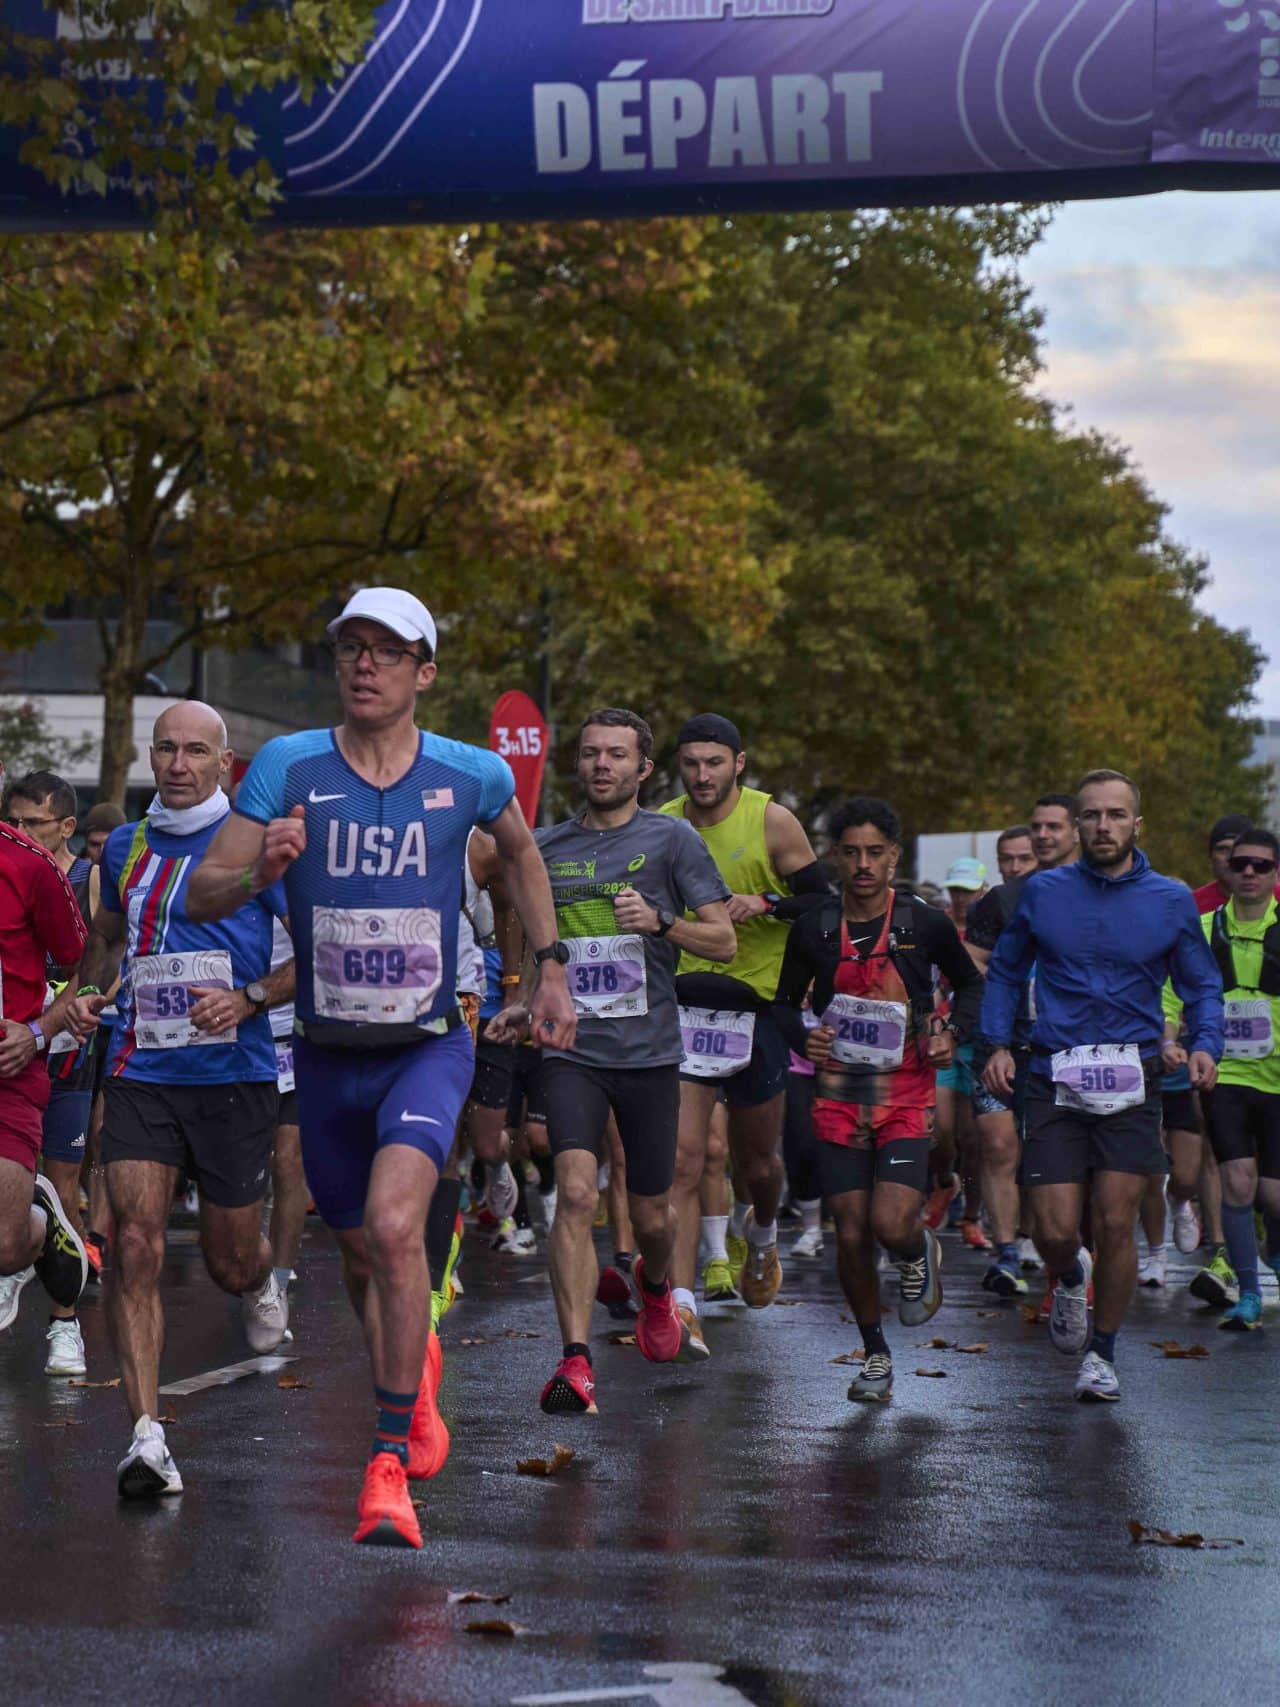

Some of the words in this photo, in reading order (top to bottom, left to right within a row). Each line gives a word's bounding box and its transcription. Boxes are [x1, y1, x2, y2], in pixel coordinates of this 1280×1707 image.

[533, 59, 884, 174] DÉPART
[326, 819, 427, 878] USA
[343, 948, 406, 985] 699
[575, 965, 619, 993] 378
[692, 1030, 727, 1055] 610
[838, 1018, 880, 1045] 208
[1080, 1067, 1117, 1091] 516
